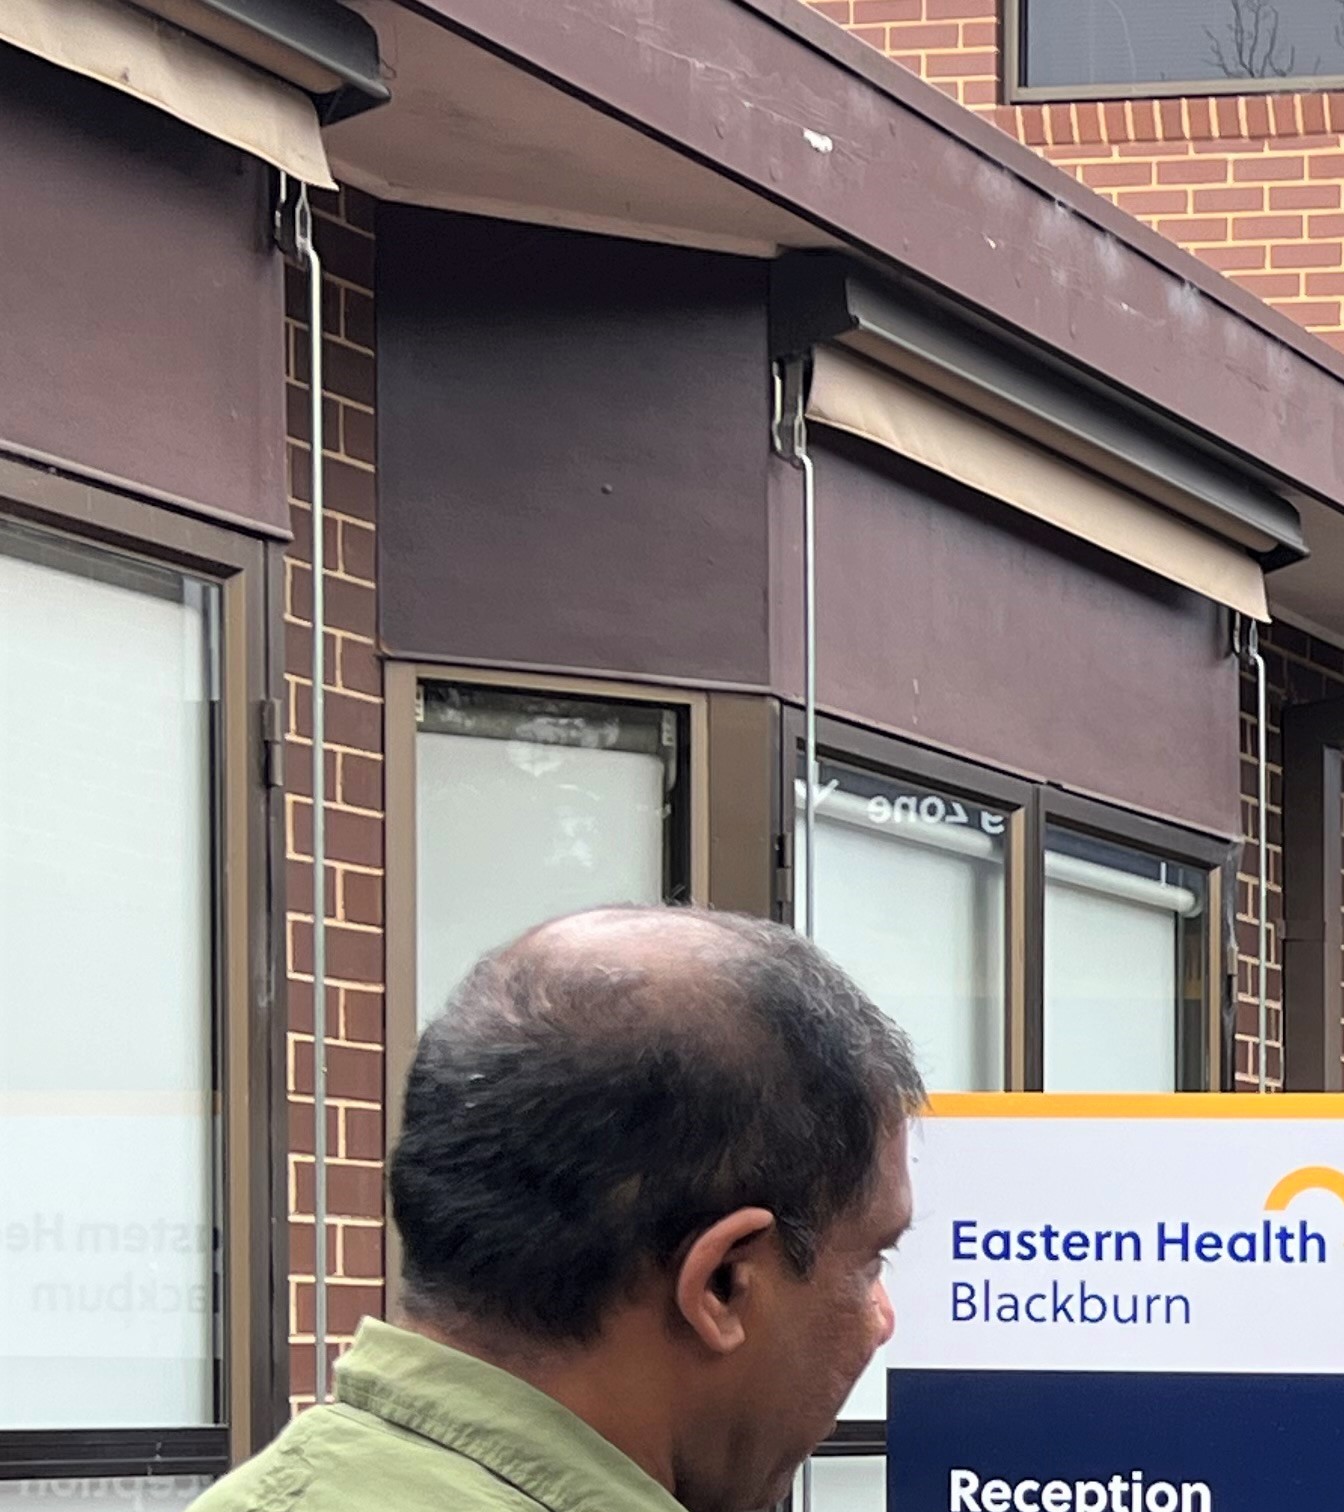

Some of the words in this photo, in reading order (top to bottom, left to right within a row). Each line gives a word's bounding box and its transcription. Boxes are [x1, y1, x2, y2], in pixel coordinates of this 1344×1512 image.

[951, 1220, 1142, 1262] Eastern
[1155, 1219, 1328, 1264] Health
[951, 1280, 1192, 1325] Blackburn
